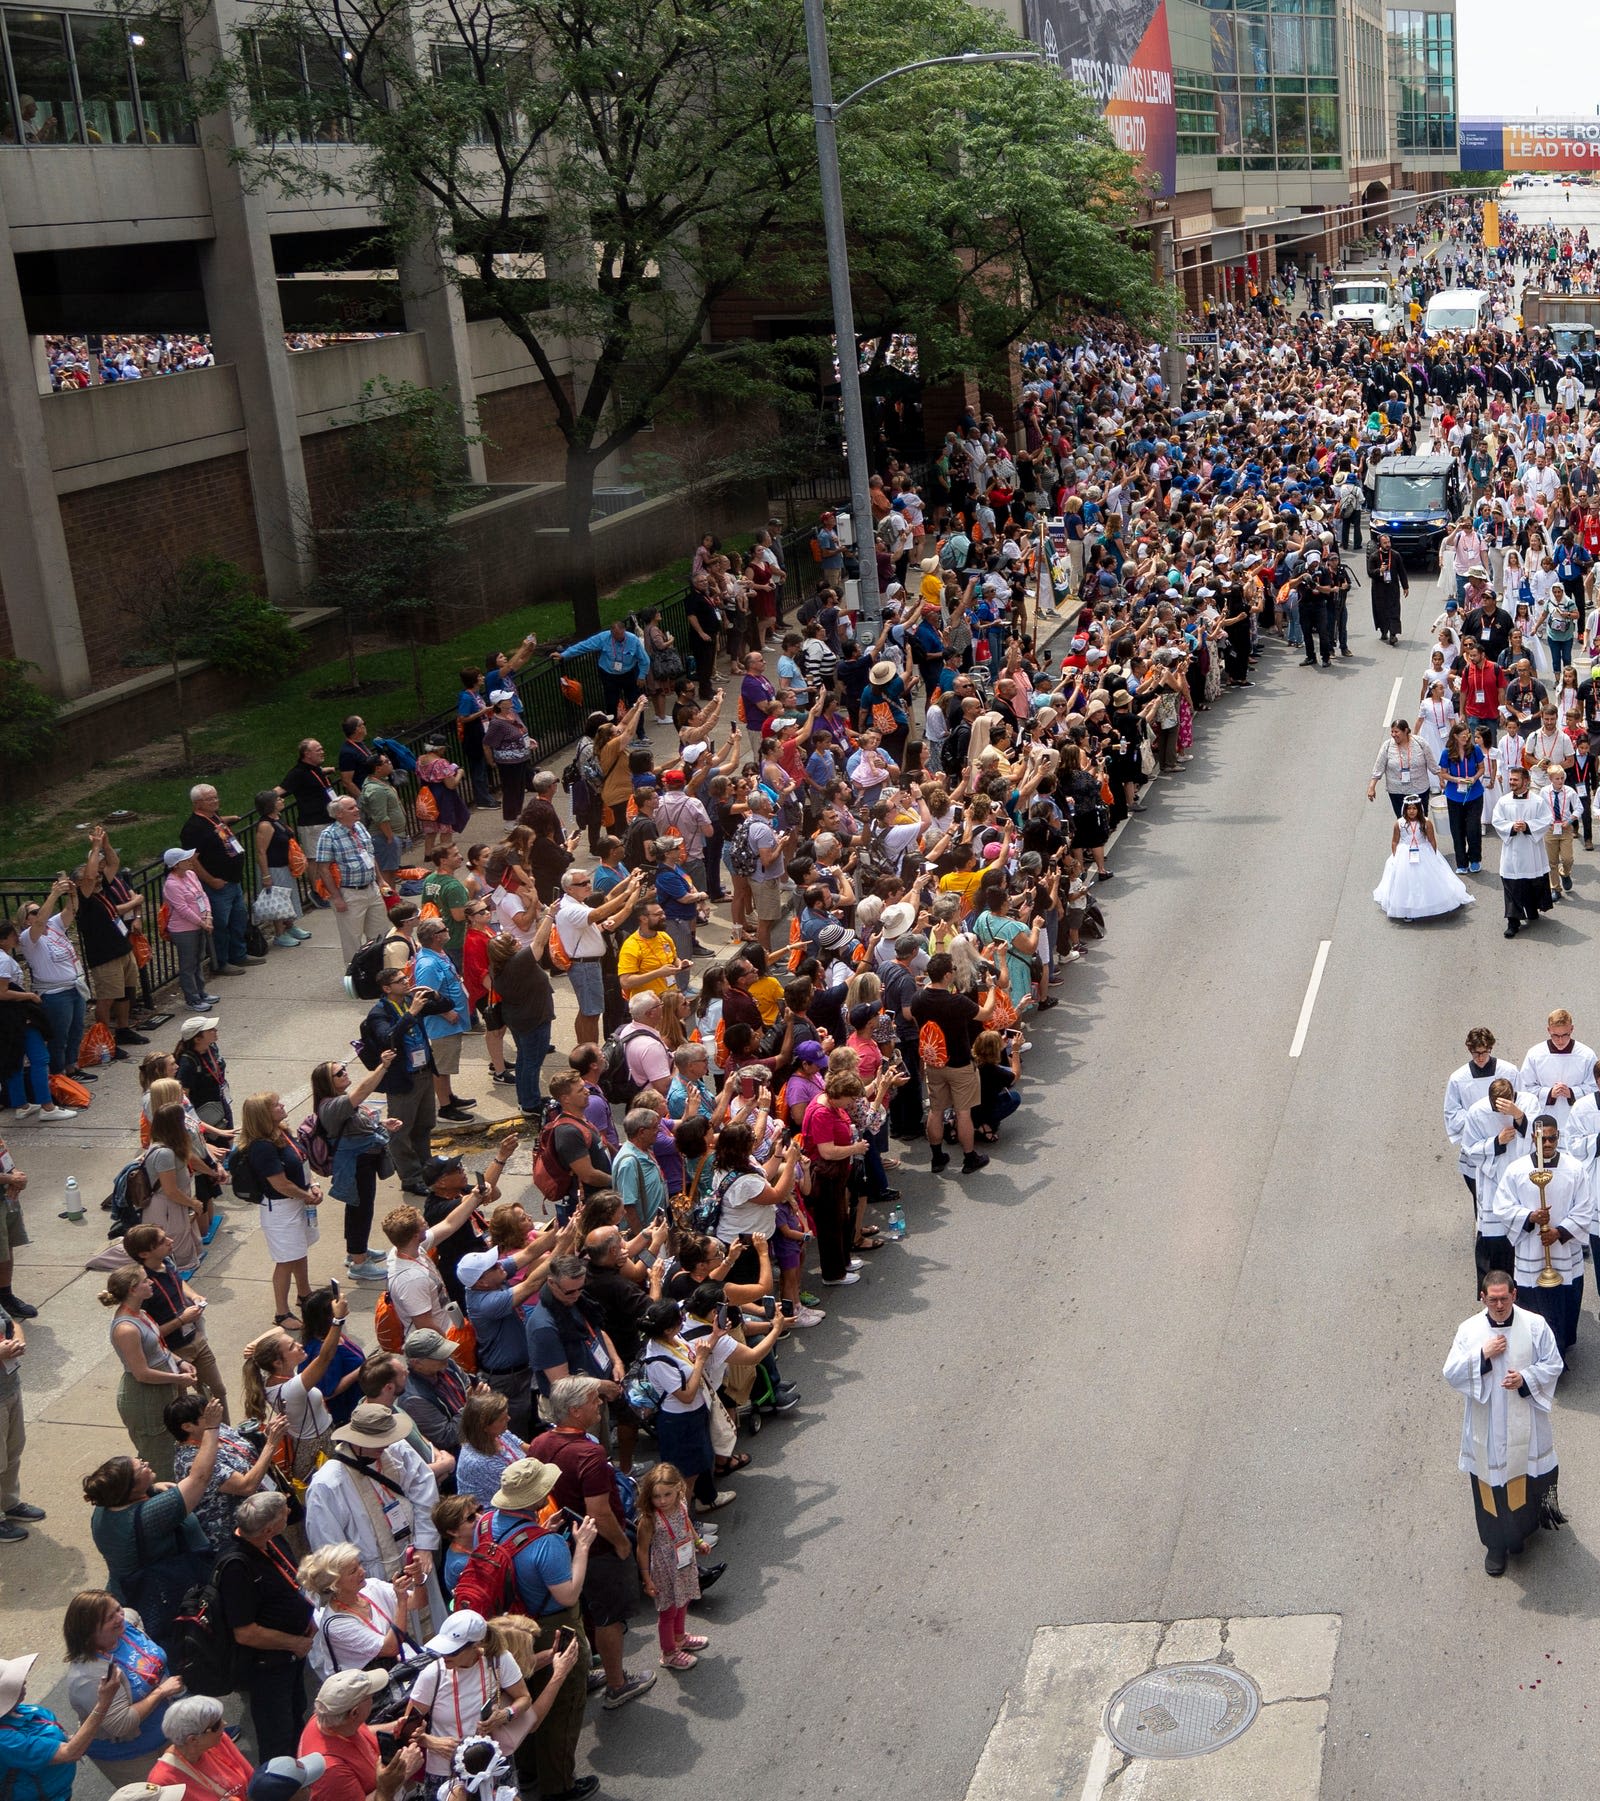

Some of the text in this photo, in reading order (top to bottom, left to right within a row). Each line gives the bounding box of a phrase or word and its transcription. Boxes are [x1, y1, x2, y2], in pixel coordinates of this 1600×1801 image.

[1071, 57, 1172, 104] ESTOS CAMINOS LLEVAN
[1509, 125, 1569, 139] THESE
[1510, 142, 1563, 157] LEAD
[1564, 142, 1587, 157] TO
